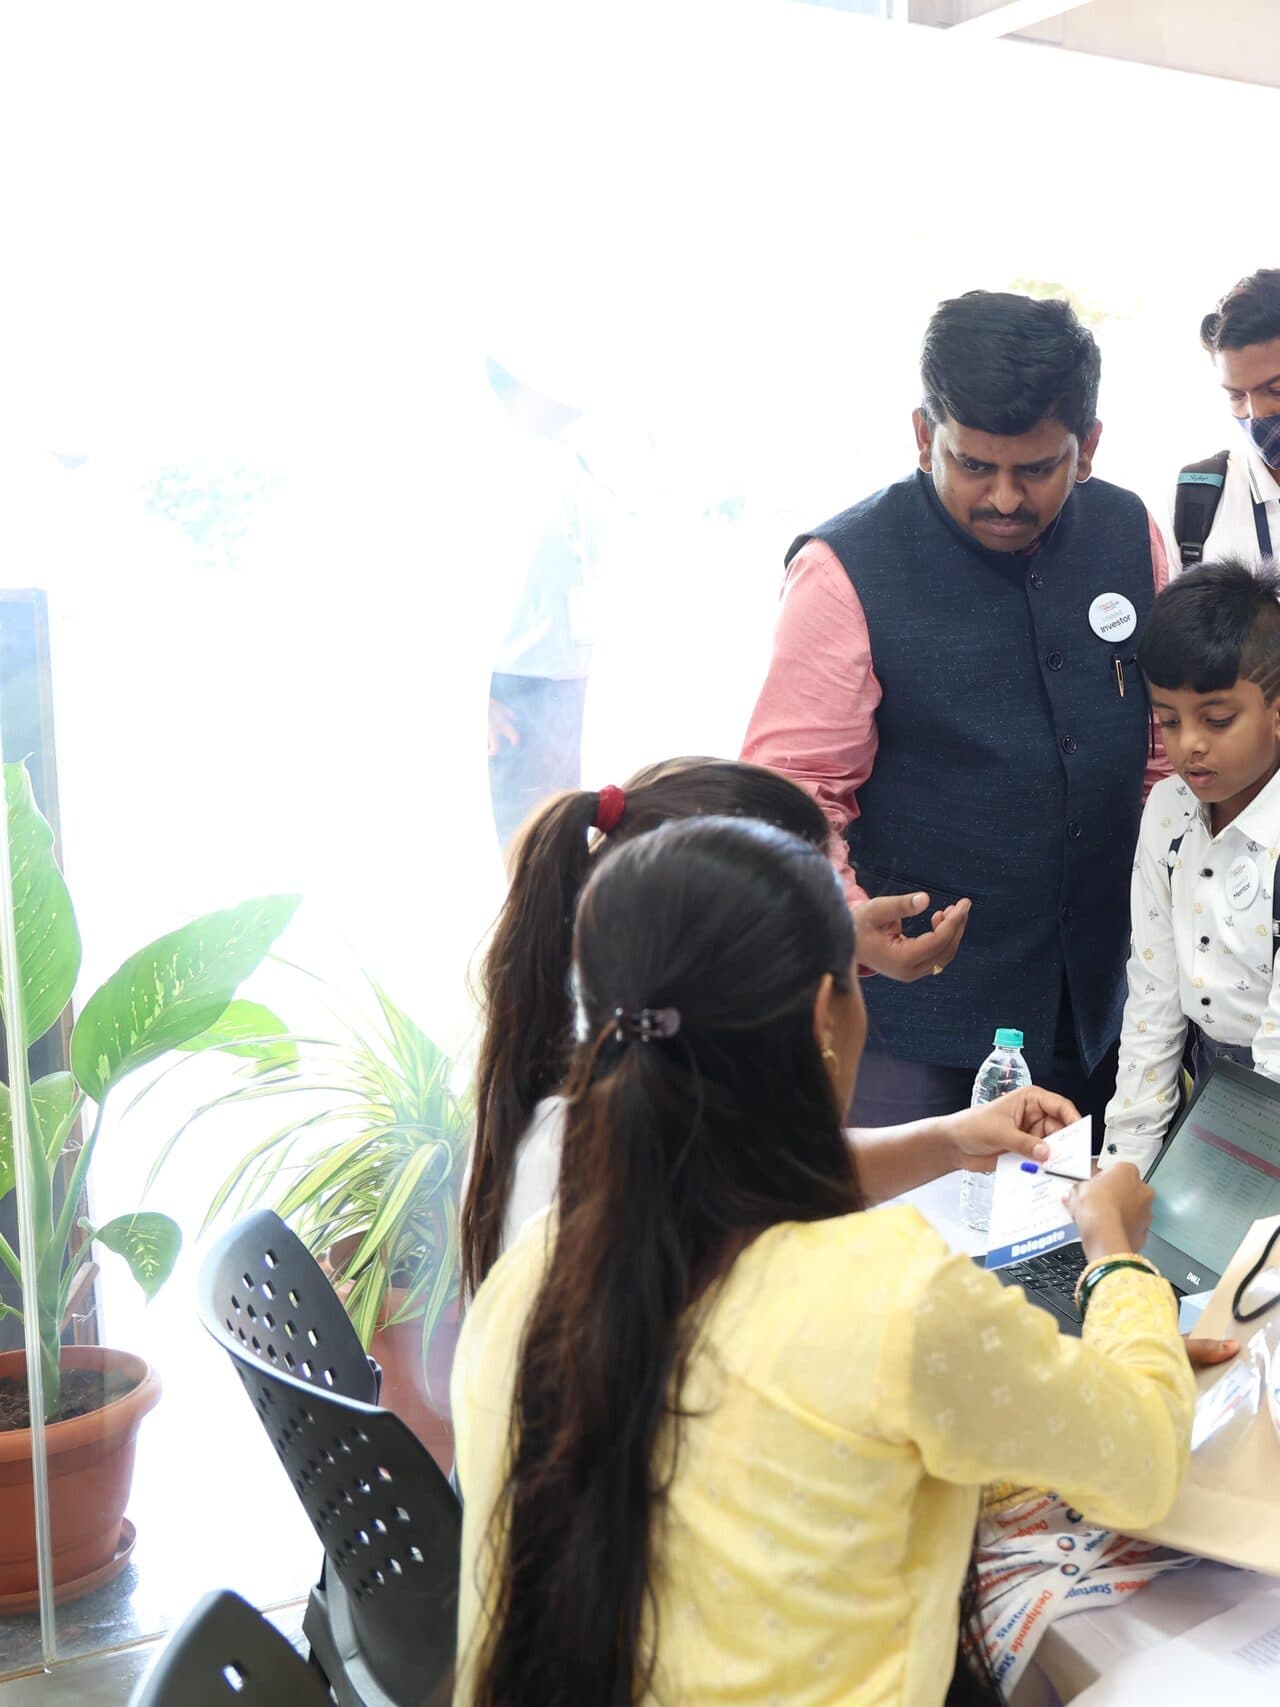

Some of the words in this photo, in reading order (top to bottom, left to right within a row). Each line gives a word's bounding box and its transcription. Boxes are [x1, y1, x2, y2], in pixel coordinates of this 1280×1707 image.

[1100, 614, 1131, 633] Investor
[1011, 1230, 1066, 1258] Delegate
[1186, 1271, 1201, 1286] DELL
[1010, 1589, 1054, 1653] Deshpande
